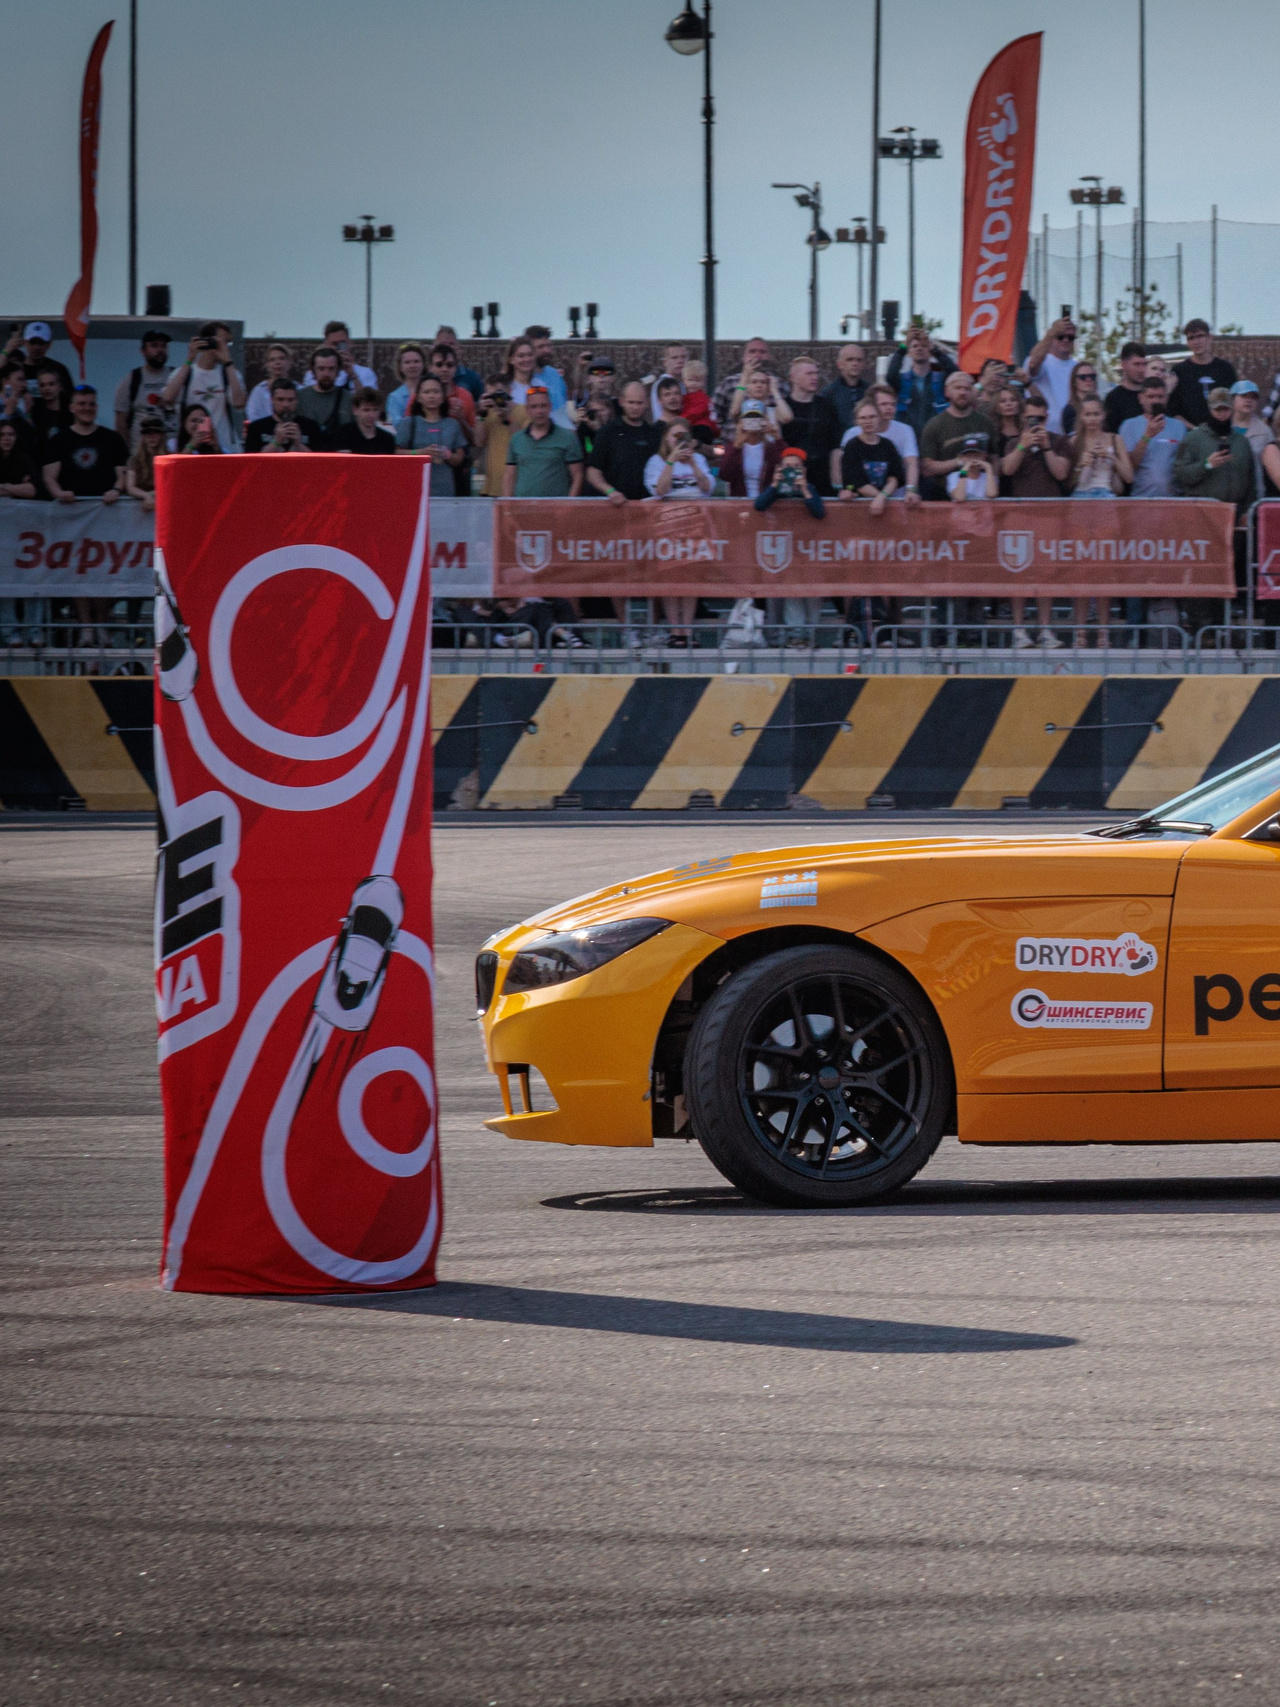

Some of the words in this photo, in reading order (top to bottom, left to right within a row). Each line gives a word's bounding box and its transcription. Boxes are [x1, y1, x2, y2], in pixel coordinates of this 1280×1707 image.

[967, 152, 1015, 337] DRYDRY
[557, 538, 729, 562] ЧЕМПИОНАТ
[797, 538, 970, 562] ЧЕМПИОНАТ
[1038, 538, 1212, 562] ЧЕМПИОНАТ
[1019, 944, 1122, 967] DRYDRY
[1046, 1006, 1147, 1019] ШИНСЕРВИС
